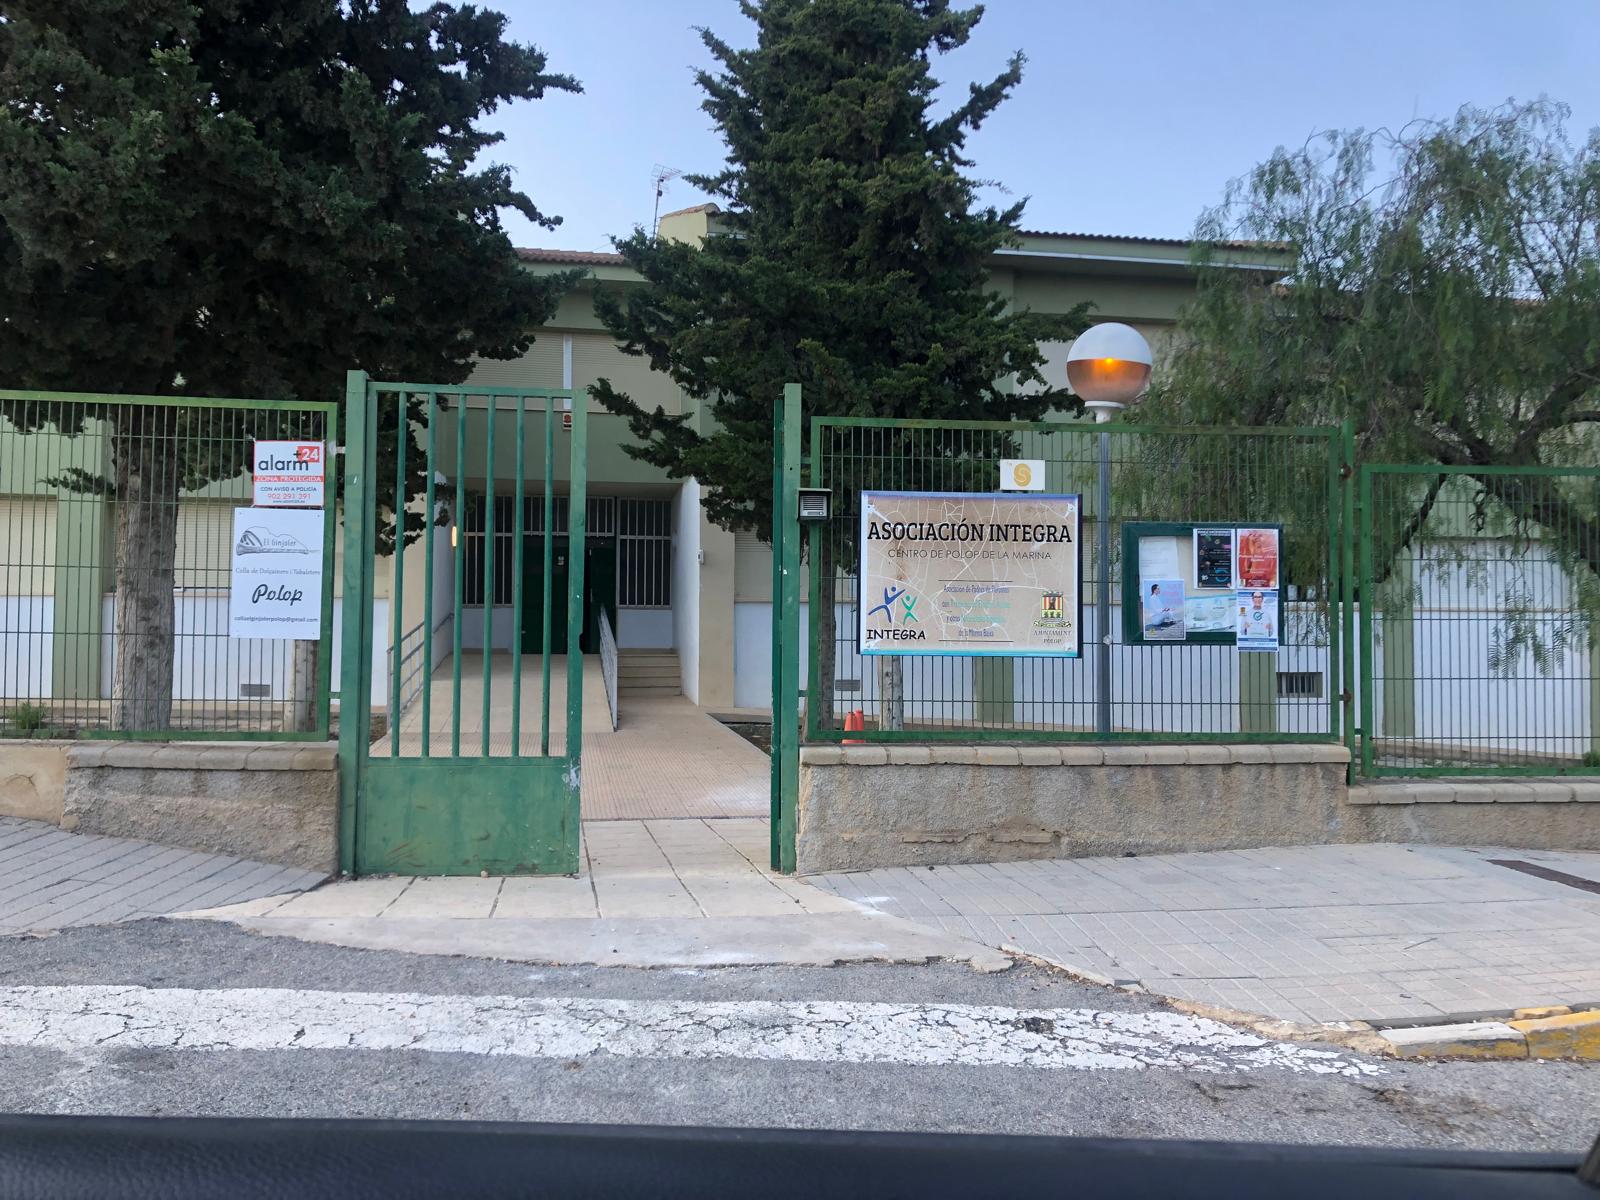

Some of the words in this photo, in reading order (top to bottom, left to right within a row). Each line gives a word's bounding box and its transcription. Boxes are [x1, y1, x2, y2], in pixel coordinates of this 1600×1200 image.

[258, 454, 309, 471] alarm
[867, 518, 984, 542] ASOCIACIÓN
[989, 523, 1073, 543] INTEGRA
[887, 549, 928, 559] CENTRO
[930, 550, 943, 559] DE
[946, 550, 980, 560] POLOP
[982, 551, 995, 560] DE
[997, 551, 1009, 560] LA
[1012, 551, 1052, 560] MARINA
[252, 583, 303, 606] Polop
[866, 629, 926, 640] INTEGRA
